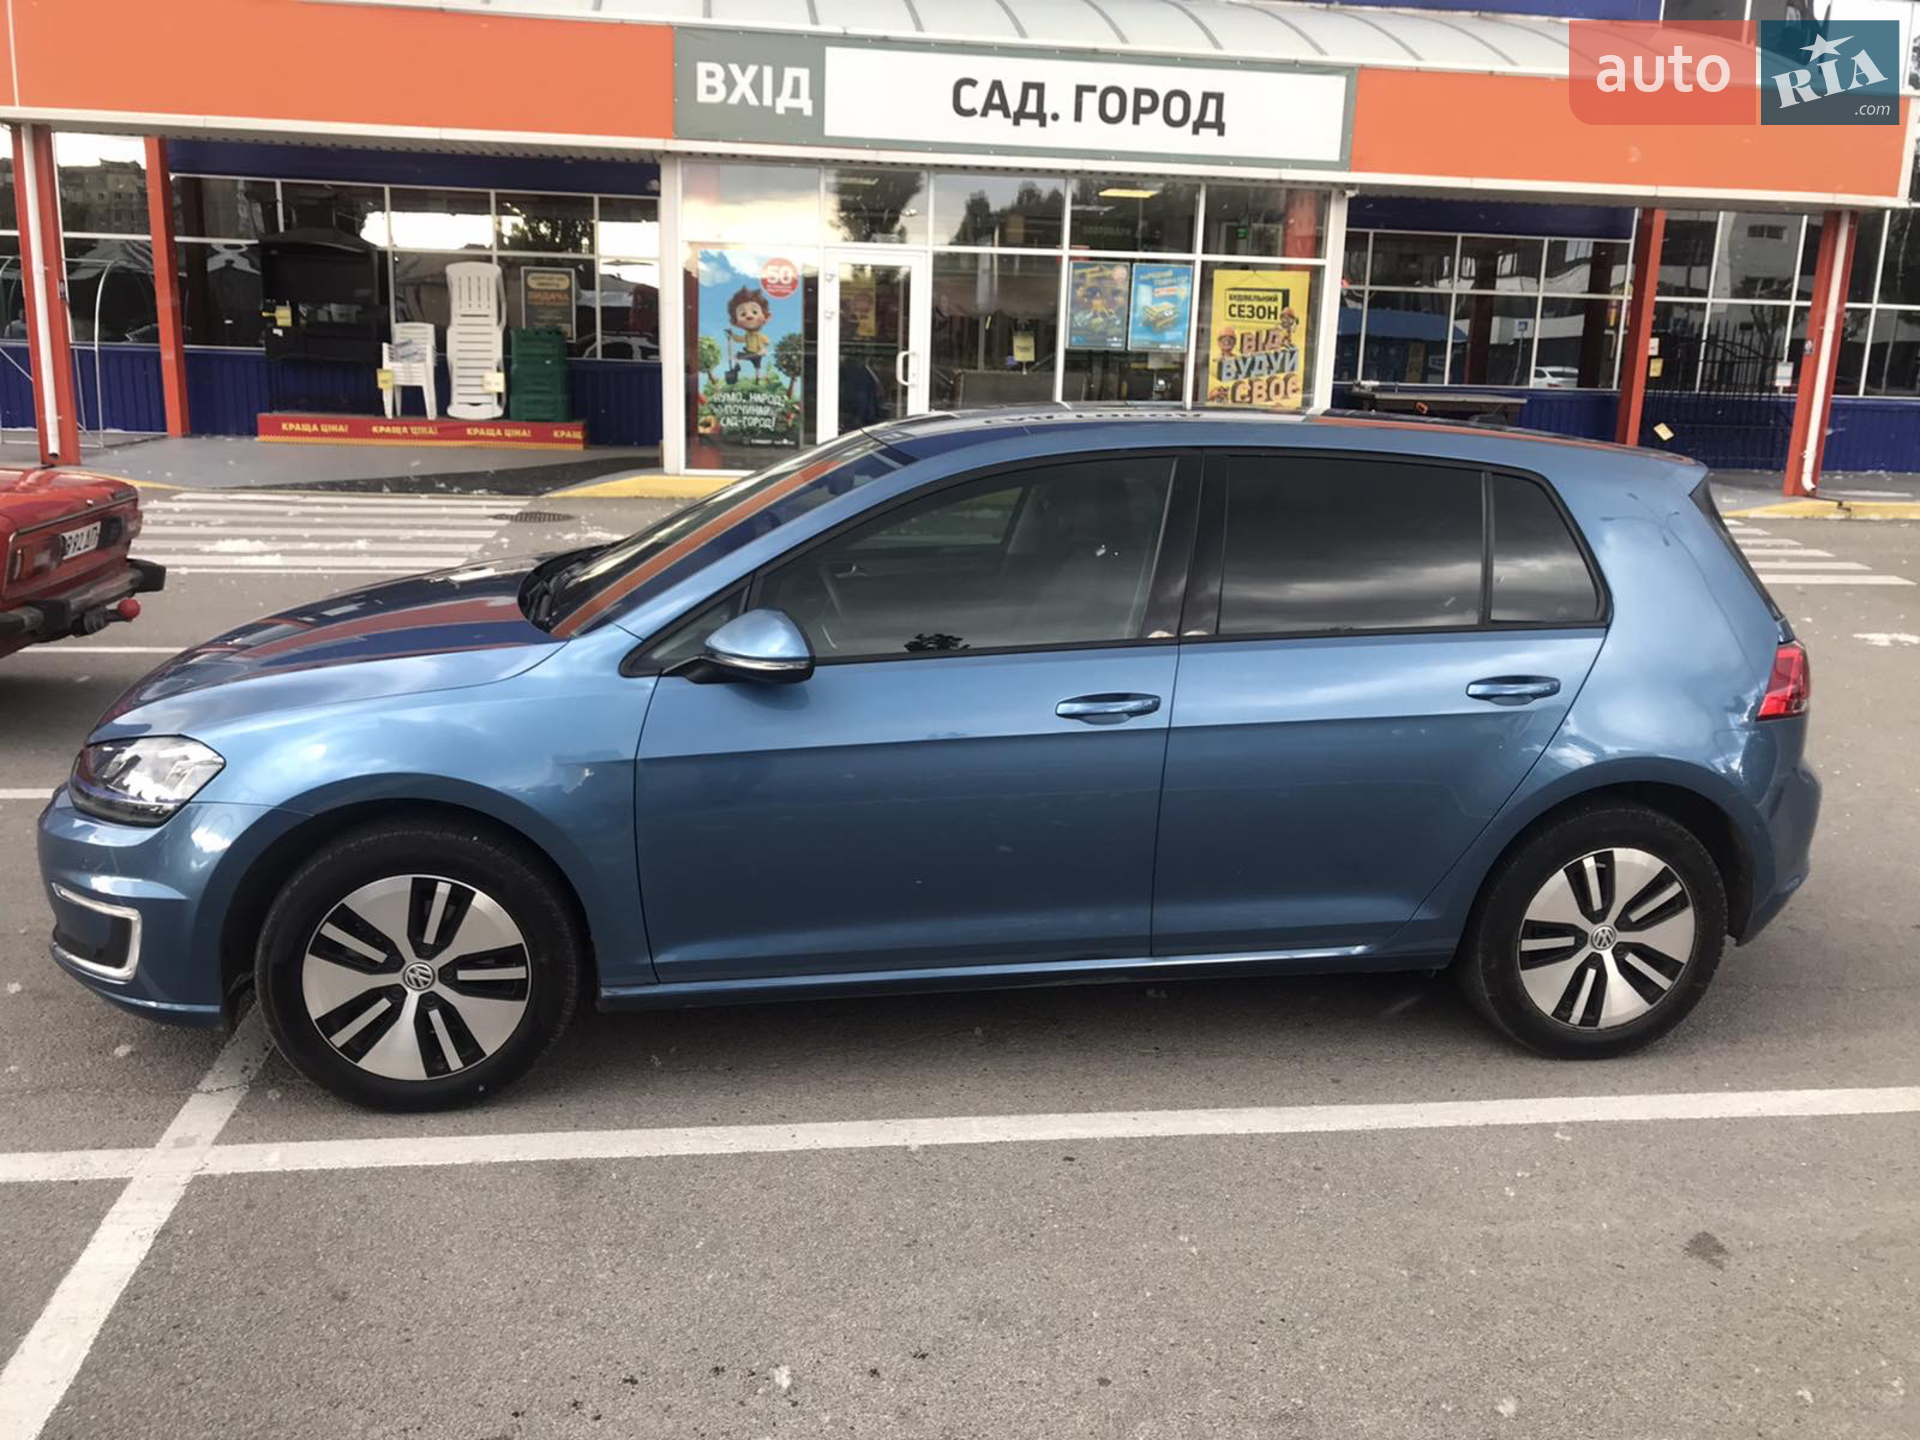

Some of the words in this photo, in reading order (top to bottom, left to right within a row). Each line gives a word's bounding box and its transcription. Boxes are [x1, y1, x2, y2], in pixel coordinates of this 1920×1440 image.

[696, 62, 812, 117] ВХІД
[952, 77, 1059, 128] САД.
[1073, 84, 1226, 136] ГОРОД
[1228, 303, 1278, 320] СЕЗОН
[281, 422, 319, 433] КРАЩА
[320, 423, 348, 433] ЦІНА!
[371, 425, 408, 435] КРАЩА
[410, 426, 438, 436] ЦІНА!
[466, 427, 502, 437] КРАЩА
[504, 428, 531, 438] ЦІНА!
